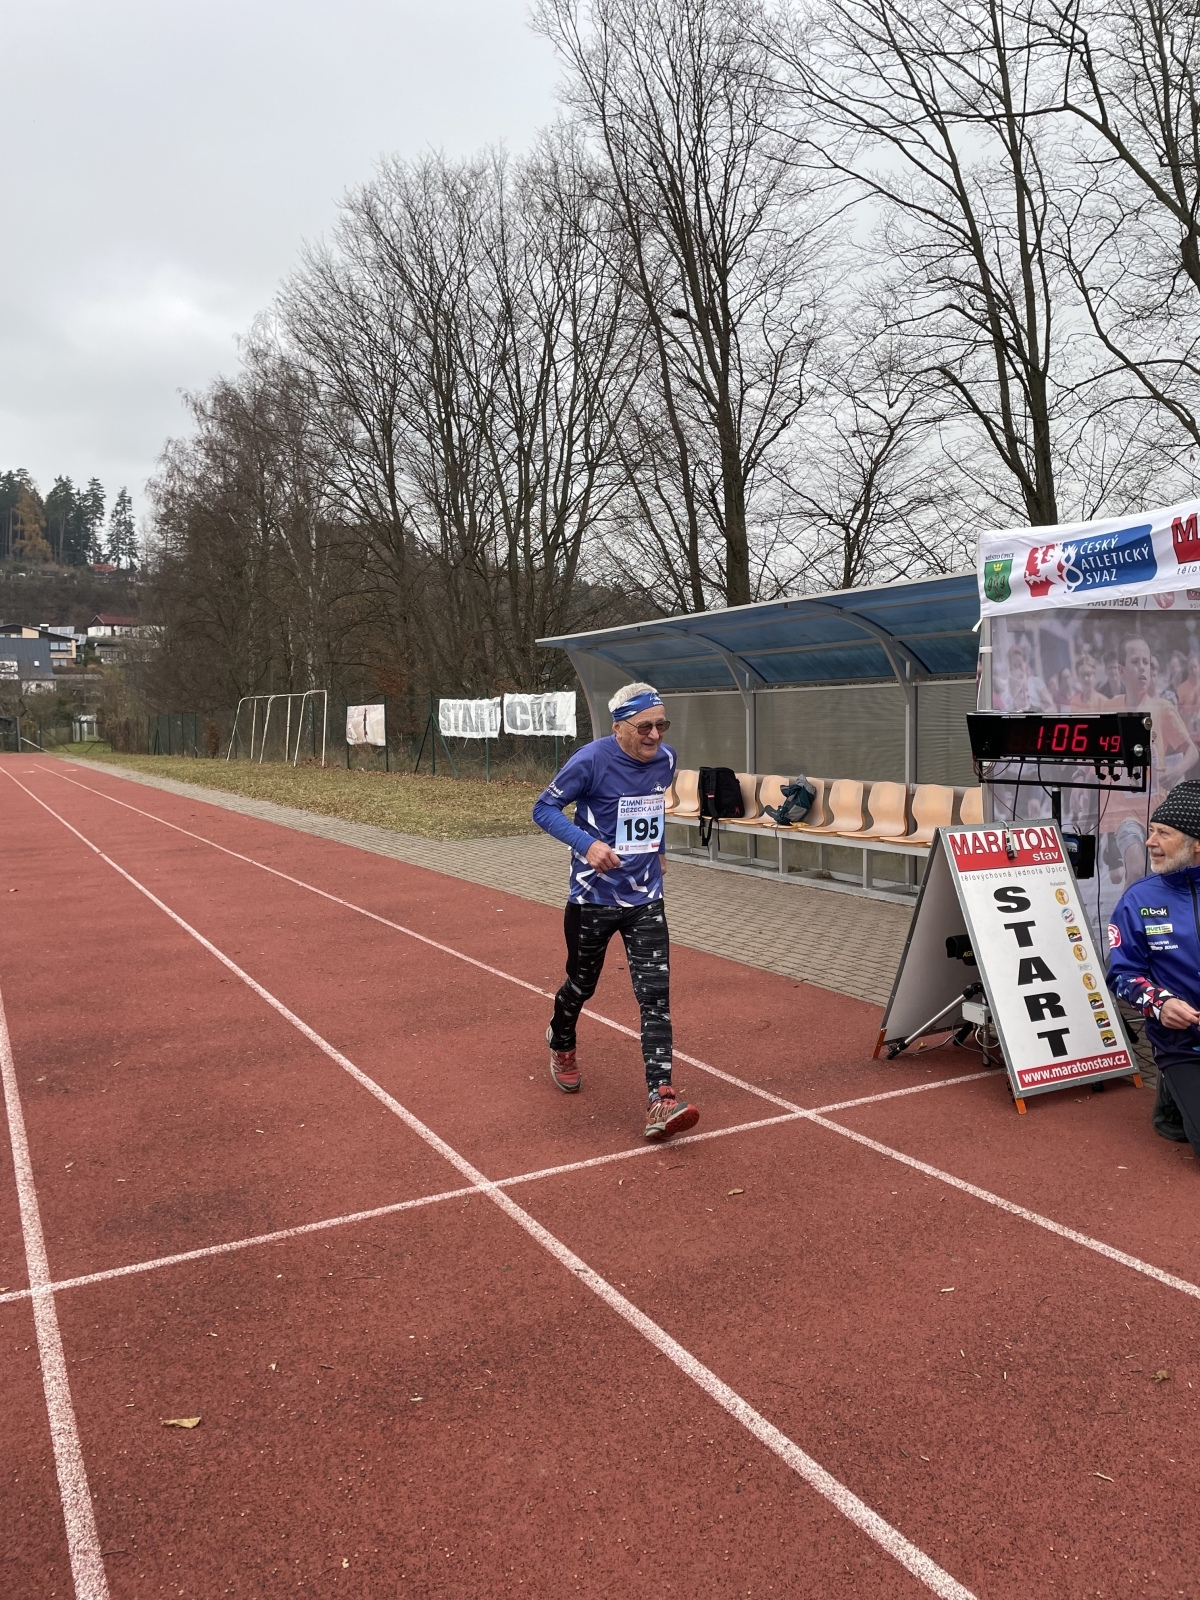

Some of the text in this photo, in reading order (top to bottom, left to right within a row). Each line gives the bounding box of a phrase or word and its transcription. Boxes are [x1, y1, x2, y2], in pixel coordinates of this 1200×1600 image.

[1080, 534, 1119, 555] ČESKÝ
[1081, 543, 1149, 571] ATLETICKÝ
[1086, 568, 1117, 585] SVAZ
[1100, 735, 1121, 752] 49
[621, 798, 643, 806] ZIMNÍ
[623, 817, 659, 841] 195
[1032, 851, 1059, 862] stav
[961, 866, 1067, 882] tělovýchovná jednota Úpice
[1149, 907, 1168, 916] bak
[993, 886, 1071, 1058] START
[1022, 1054, 1127, 1084] www.maratonstav.cz
